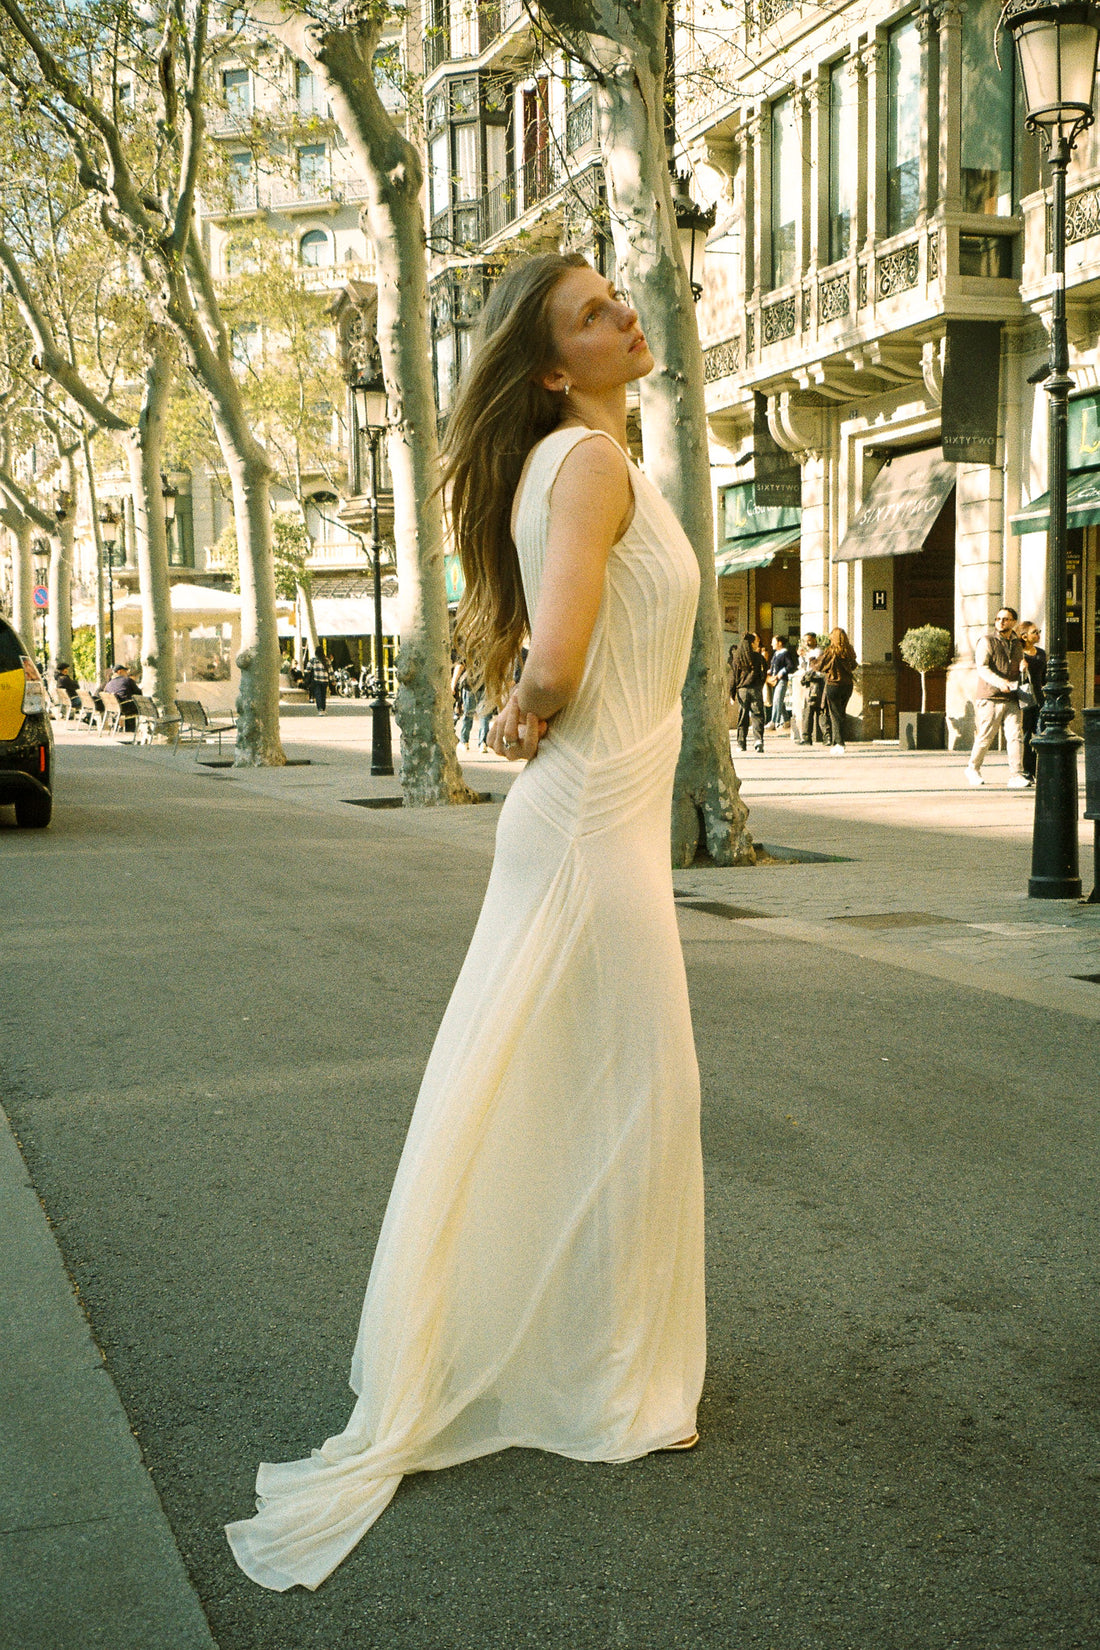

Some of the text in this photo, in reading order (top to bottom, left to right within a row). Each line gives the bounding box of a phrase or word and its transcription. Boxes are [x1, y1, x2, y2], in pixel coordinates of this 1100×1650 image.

[943, 436, 994, 445] SIXTYTWO
[756, 484, 800, 492] SIXTYTWO
[859, 496, 938, 525] SIXTYTWO
[875, 592, 884, 605] H
